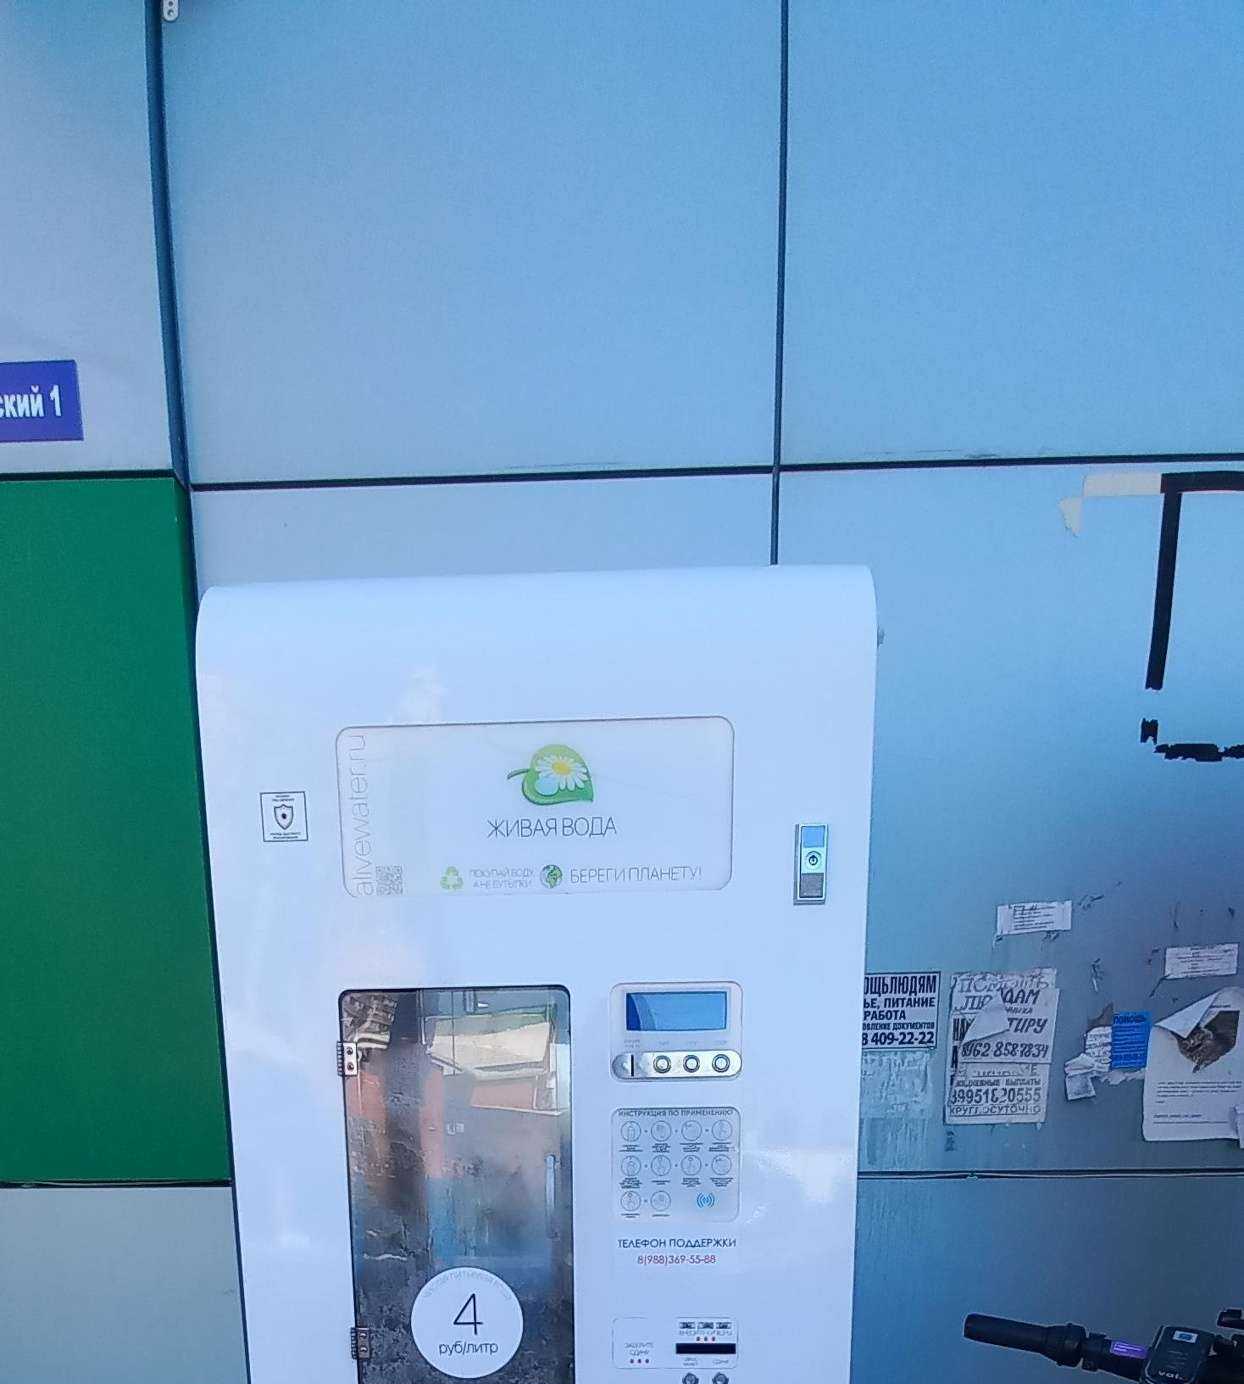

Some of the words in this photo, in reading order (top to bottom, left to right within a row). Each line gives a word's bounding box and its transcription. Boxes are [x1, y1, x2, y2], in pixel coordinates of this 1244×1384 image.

[49, 384, 62, 417] 1
[349, 734, 374, 896] alivewater.ru
[487, 816, 557, 838] ЖИВАЯ
[561, 816, 617, 838] ВОДА
[570, 867, 626, 884] БЕРЕГИ
[628, 865, 702, 883] ПЛАНЕТУ!
[863, 998, 880, 1009] ЬЕ,
[884, 997, 936, 1009] ПИТАНИЕ
[863, 1009, 906, 1021] РАБОТА
[1007, 1017, 1049, 1034] ТИРУ
[871, 1031, 935, 1046] 409-22-22
[668, 1109, 679, 1117] ПО
[617, 1239, 666, 1249] ТЕЛЕФОН
[669, 1238, 737, 1248] ПОДДЕРЖКИ
[637, 1254, 716, 1266] 8(988)369-55-88
[453, 1293, 484, 1336] 4
[438, 1340, 499, 1356] руб/литр
